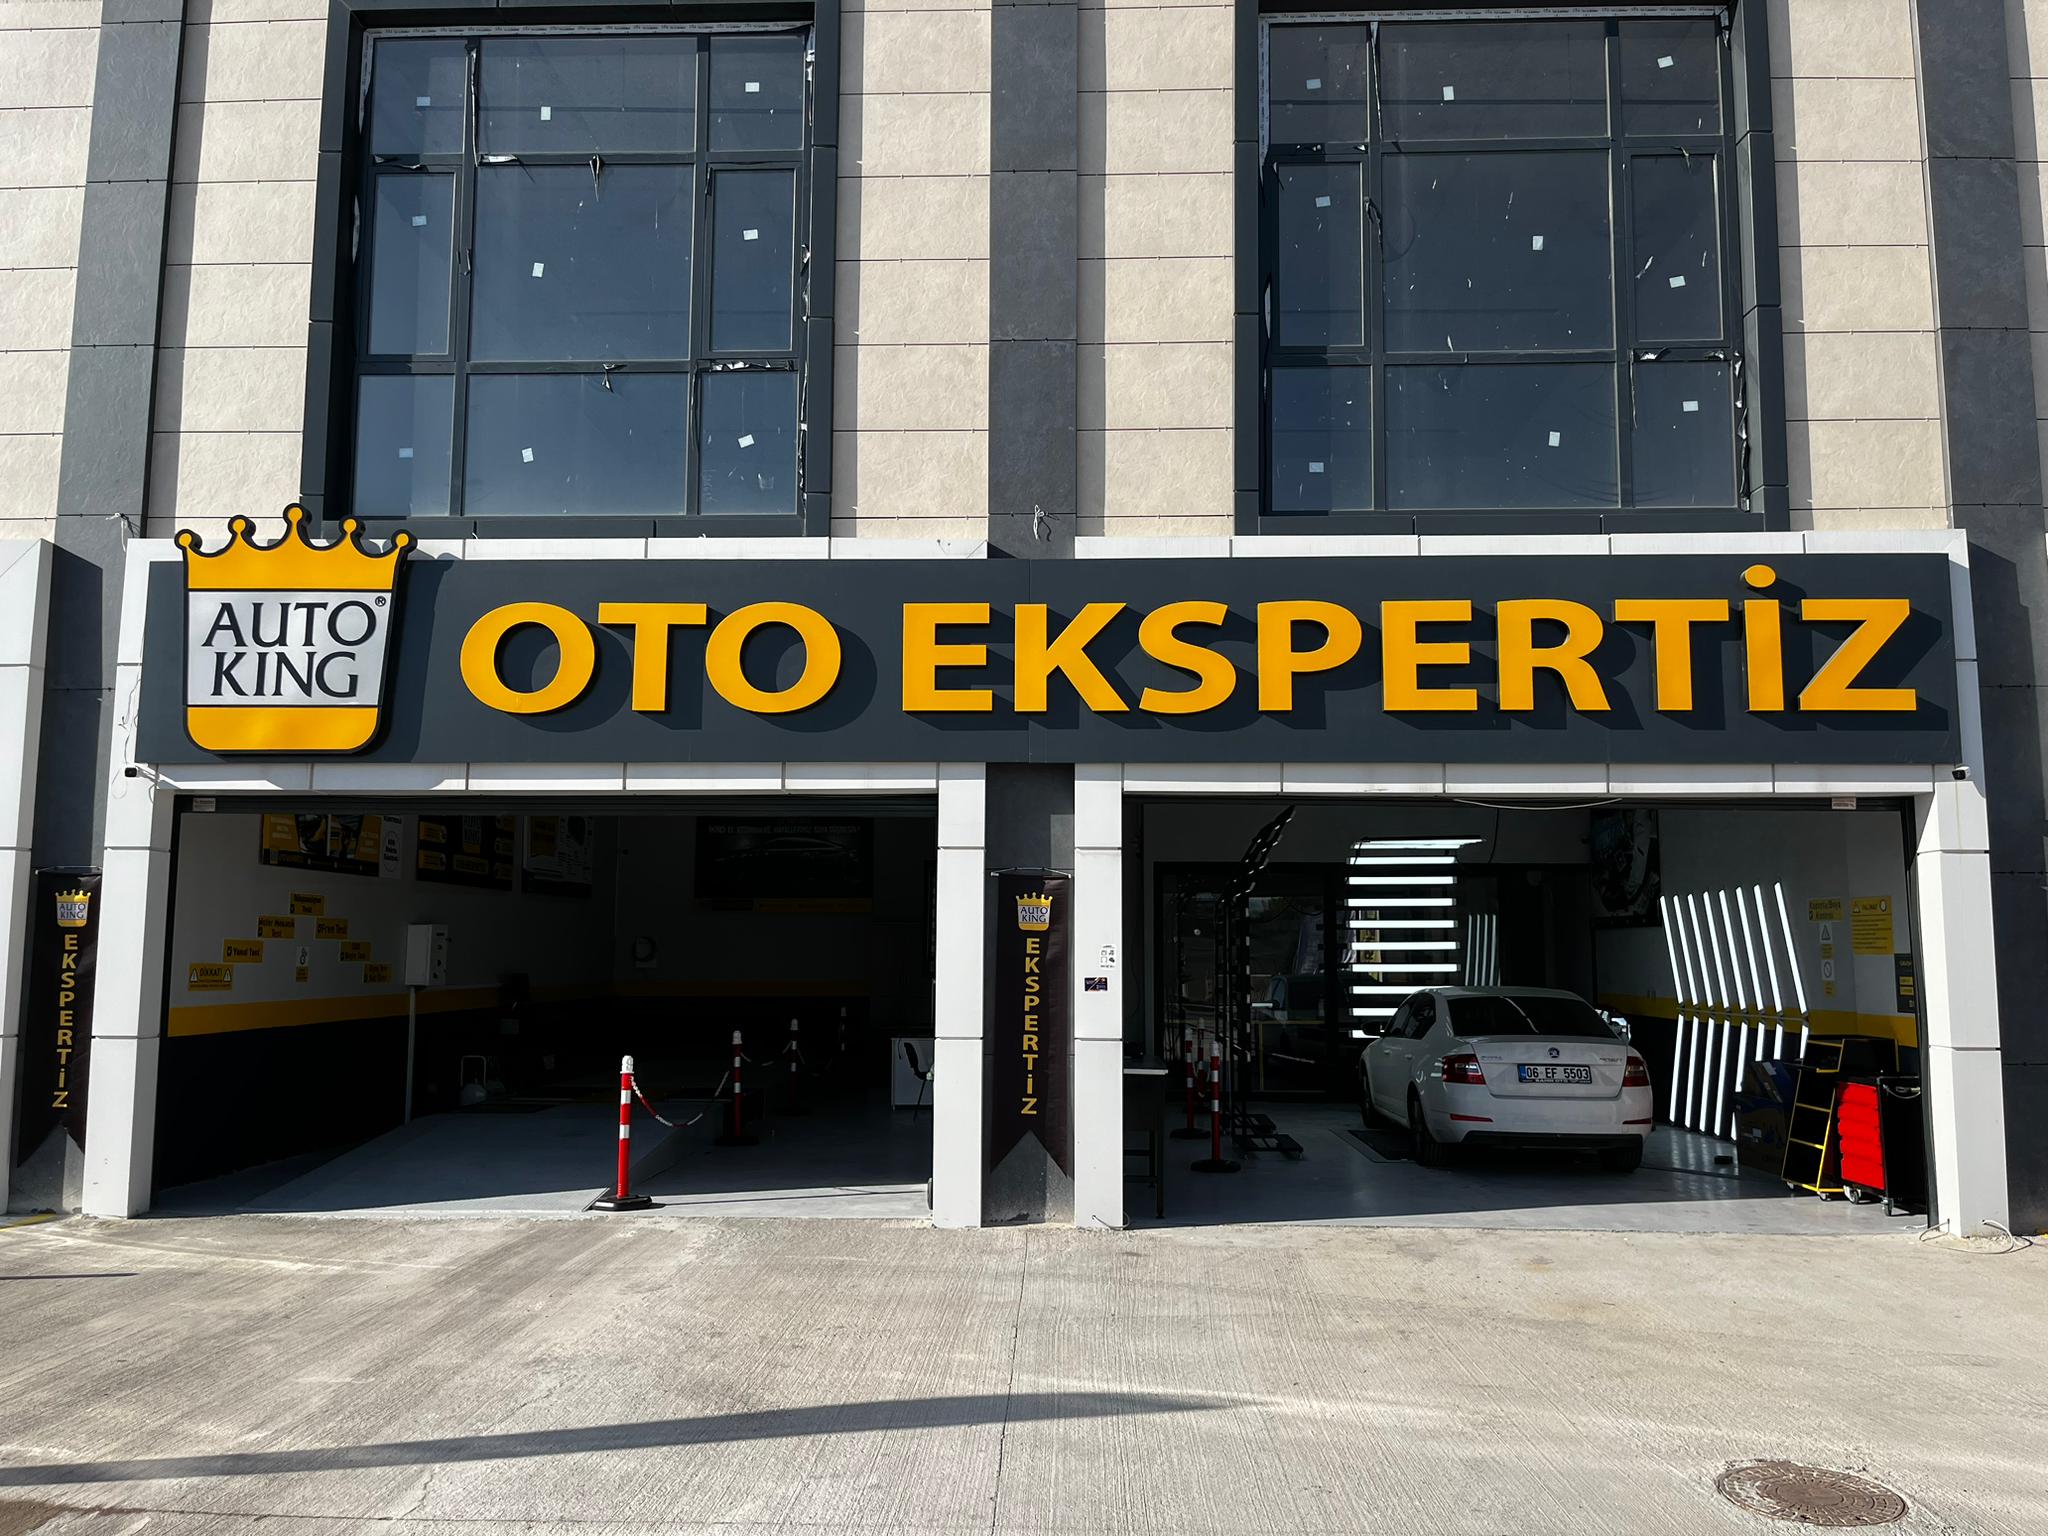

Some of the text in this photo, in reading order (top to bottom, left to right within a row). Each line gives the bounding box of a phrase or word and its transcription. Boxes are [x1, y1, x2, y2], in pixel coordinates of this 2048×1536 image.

[201, 600, 377, 648] AUTO
[460, 564, 1917, 714] OTO EKSPERTİZ
[210, 652, 358, 698] KING
[59, 903, 86, 912] AUTO
[60, 911, 84, 919] KING
[1020, 906, 1048, 915] AUTO
[1022, 914, 1047, 923] KING
[51, 934, 78, 1109] EKSPERTİZ
[1021, 937, 1040, 1115] EKSPERTİZ
[1526, 1066, 1590, 1080] 06 EF 5503
